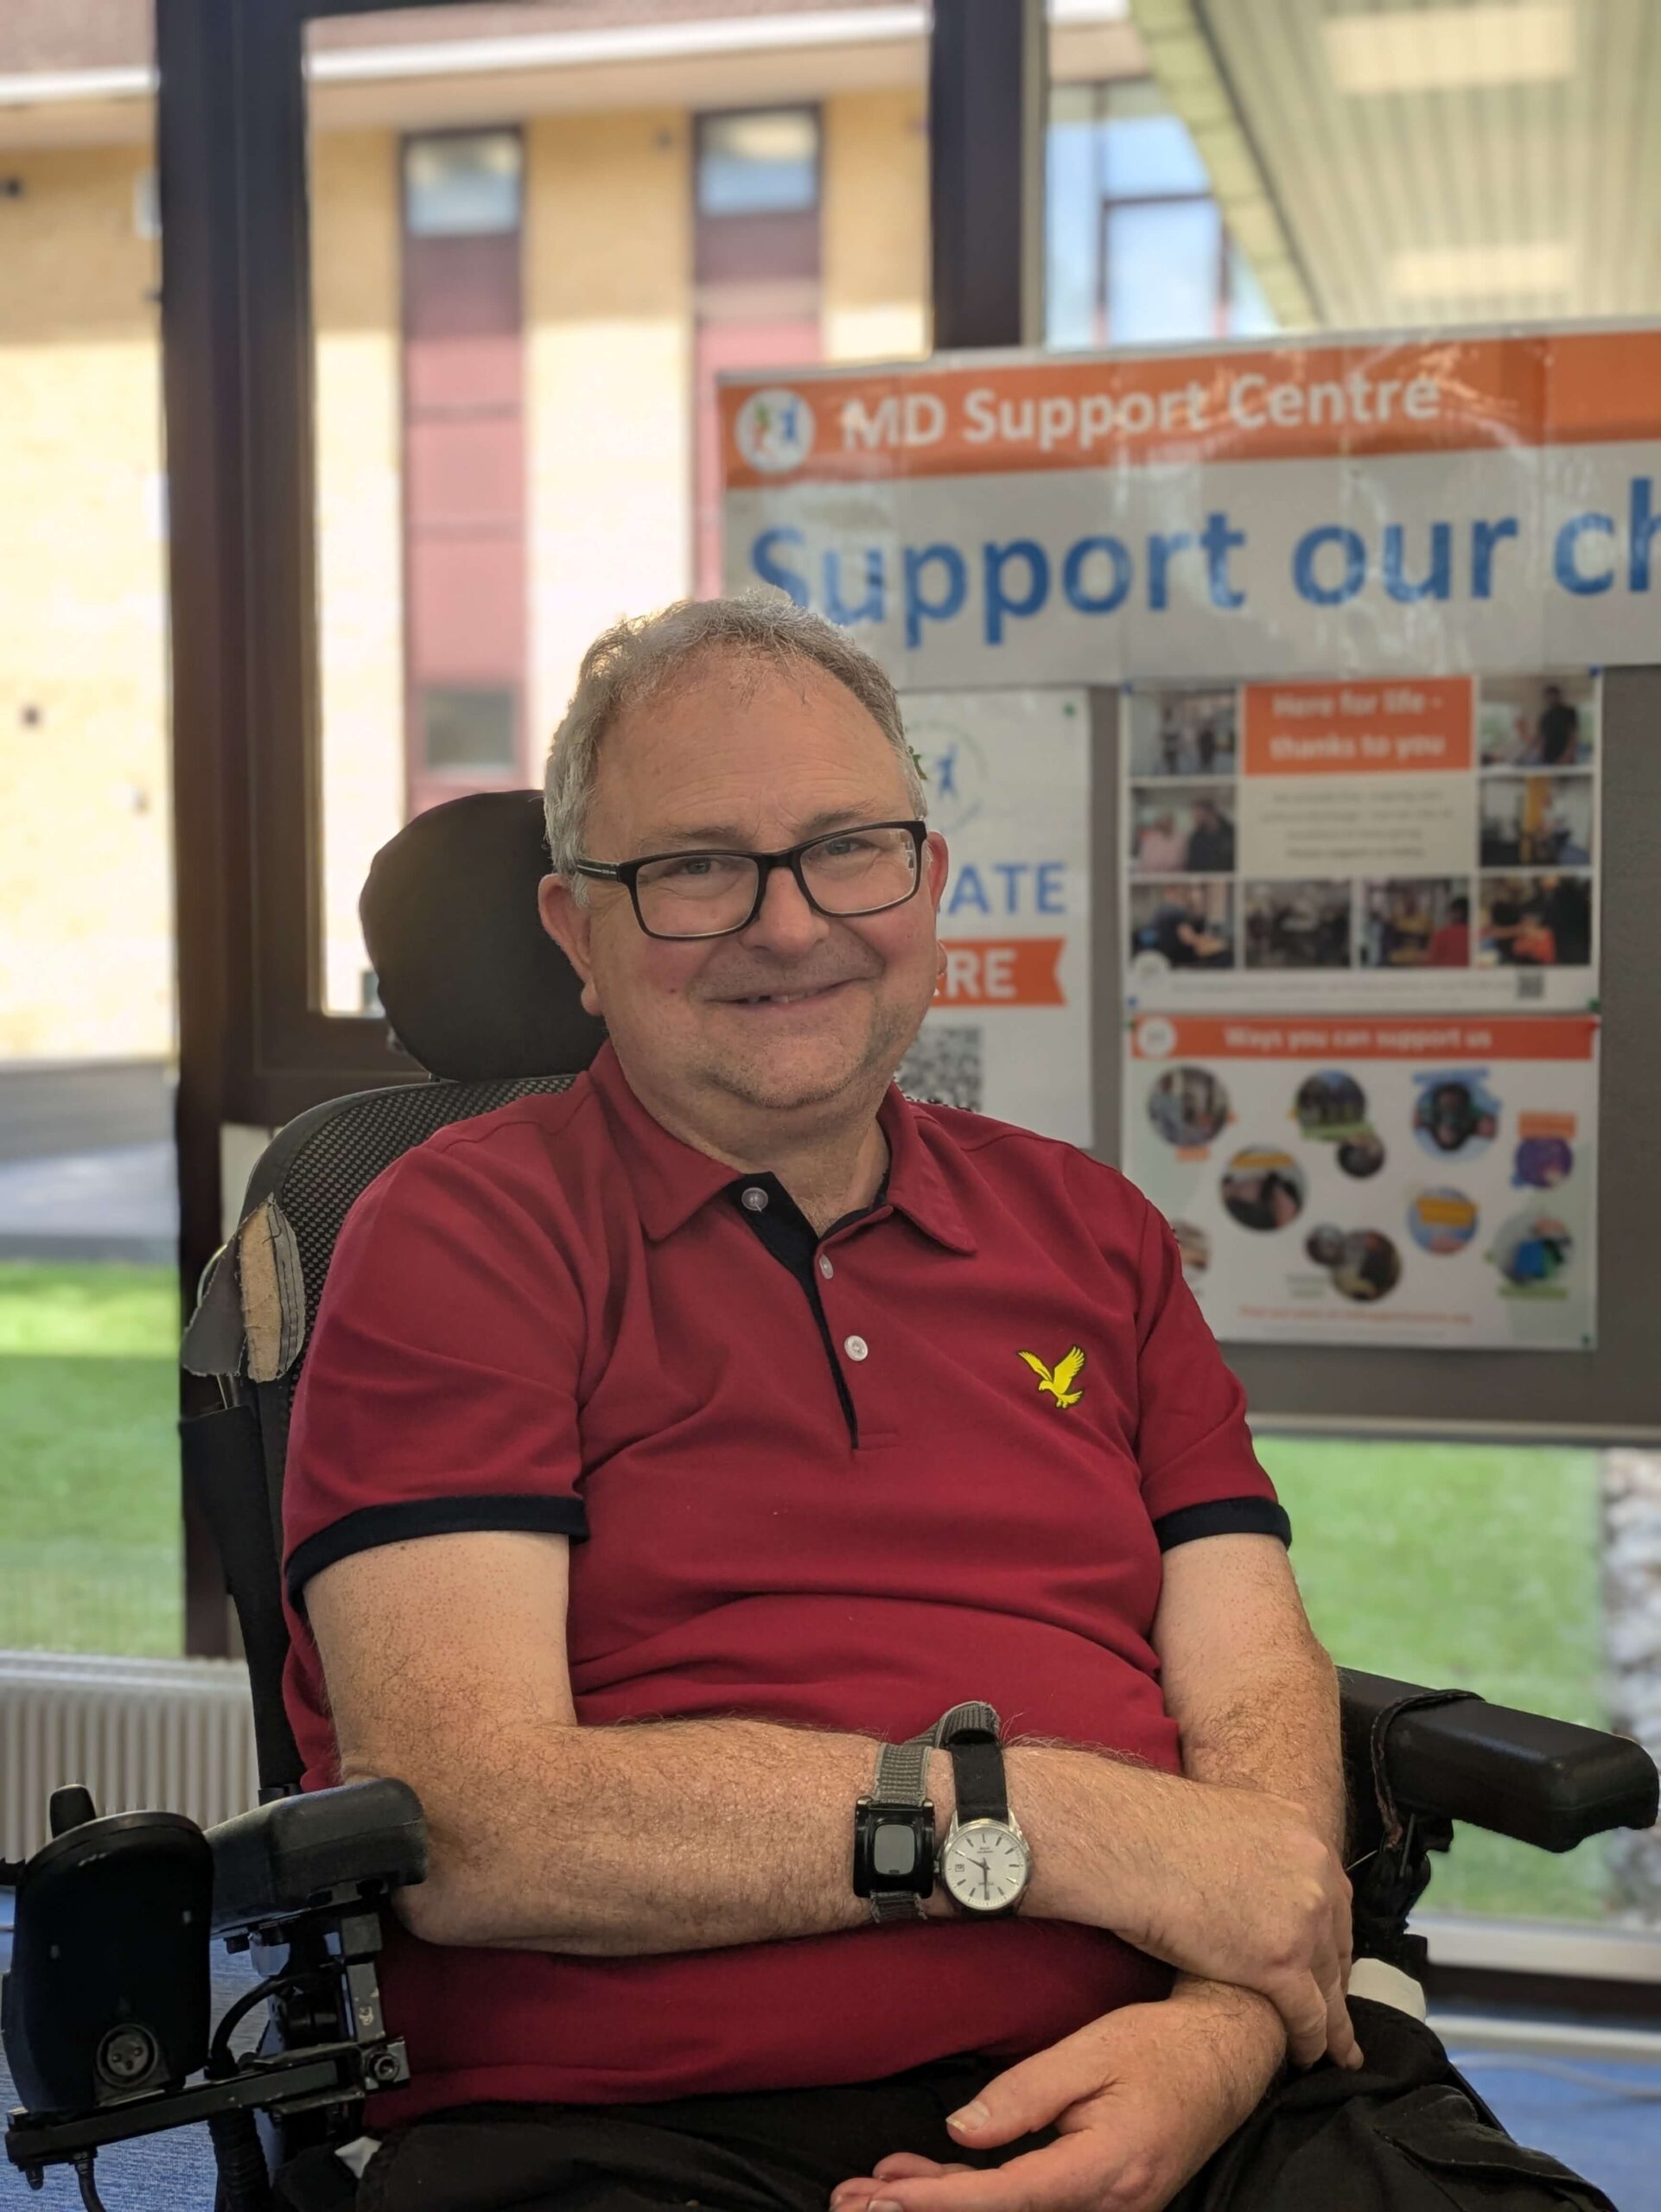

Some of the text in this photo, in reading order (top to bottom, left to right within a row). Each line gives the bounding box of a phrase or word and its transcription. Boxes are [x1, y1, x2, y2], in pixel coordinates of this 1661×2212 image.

[841, 371, 1441, 451] MD Support Centre
[748, 512, 1245, 649] Support
[1291, 517, 1518, 607] our
[1272, 692, 1333, 718] Here
[1340, 689, 1377, 716] for
[1270, 731, 1446, 762] thanks to you
[938, 862, 1066, 914] ATE
[935, 950, 1017, 997] RE
[1223, 1027, 1492, 1052] Ways you can support us
